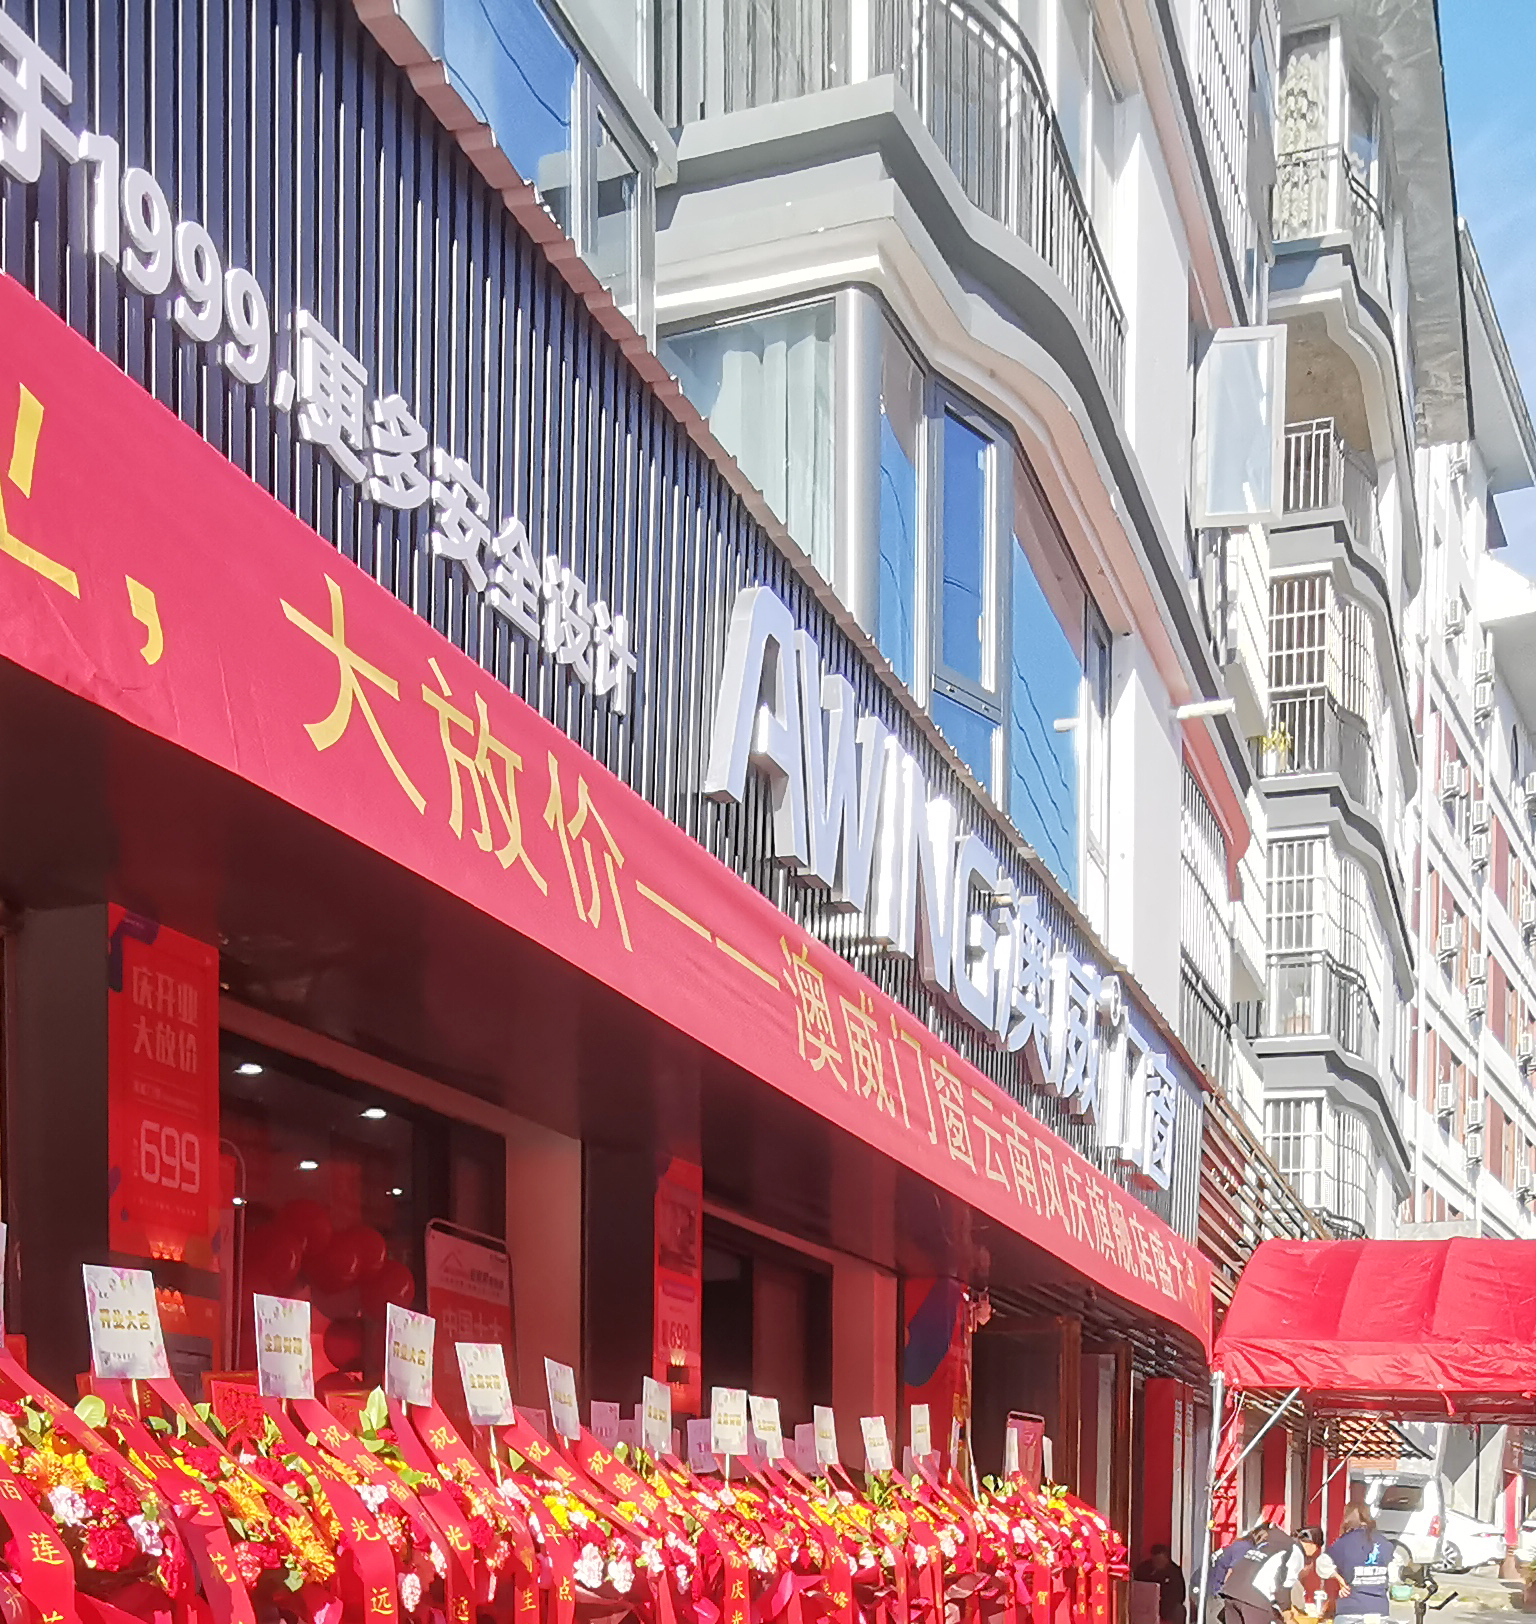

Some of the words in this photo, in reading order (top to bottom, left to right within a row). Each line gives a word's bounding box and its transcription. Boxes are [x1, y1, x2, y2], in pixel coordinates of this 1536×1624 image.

[132, 965, 199, 1028] 庆开业
[132, 1014, 198, 1074] 大放价
[140, 1120, 200, 1194] 699
[98, 1308, 152, 1331] 开业大吉
